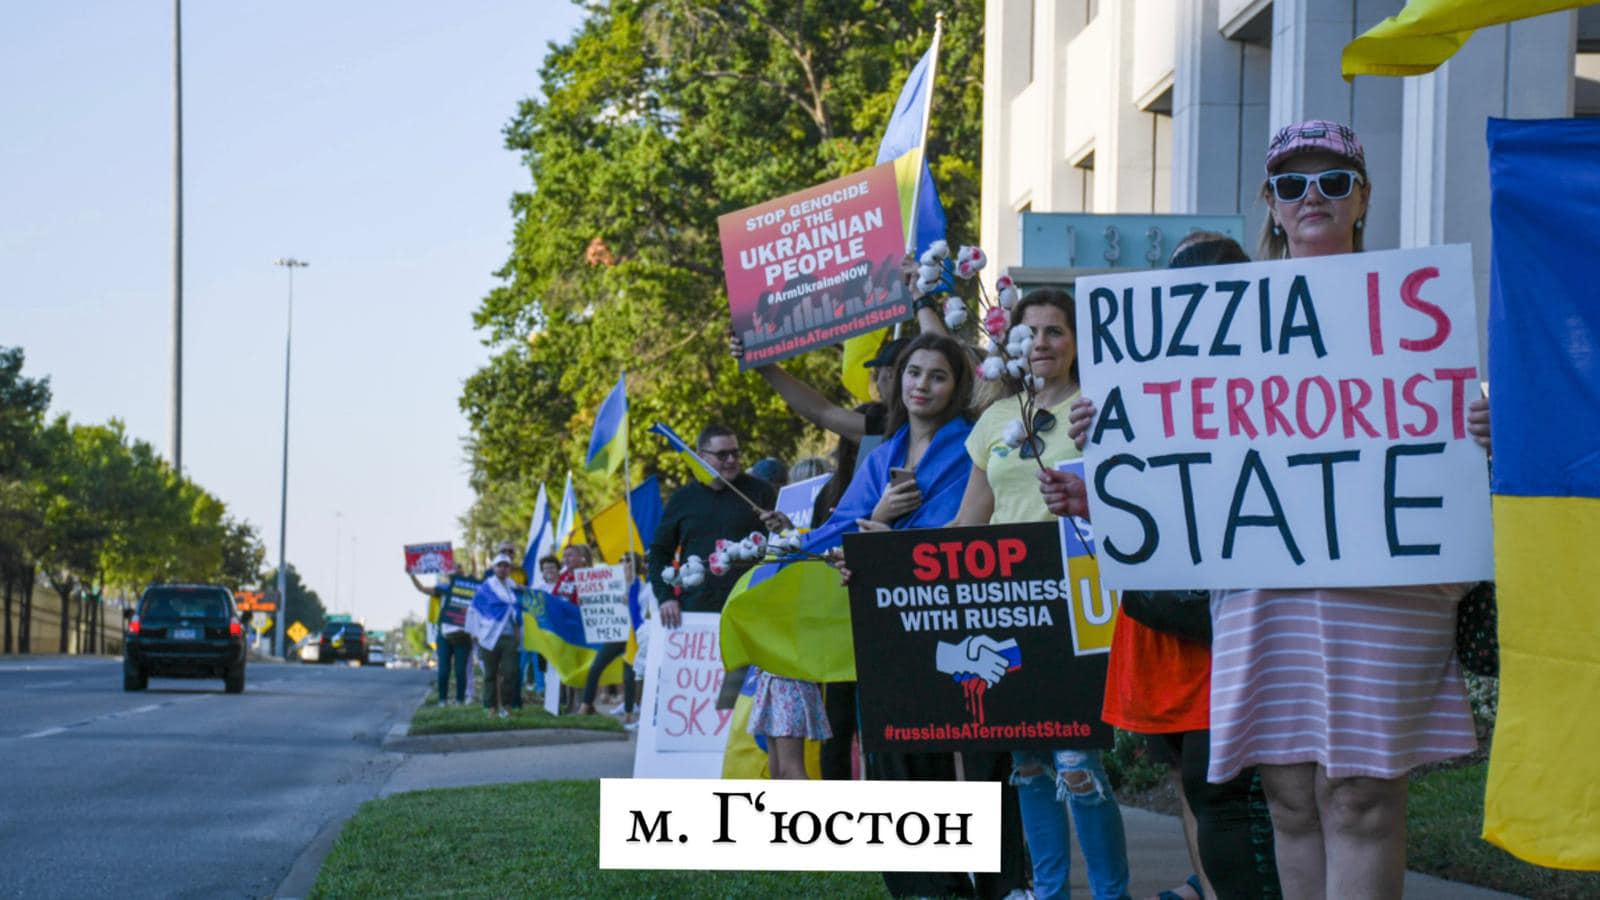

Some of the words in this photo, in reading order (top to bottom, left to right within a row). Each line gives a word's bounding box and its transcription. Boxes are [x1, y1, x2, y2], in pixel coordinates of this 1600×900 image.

[746, 209, 786, 232] STOP
[790, 180, 870, 218] GENOCIDE
[780, 219, 801, 236] OF
[804, 208, 834, 229] THE
[740, 207, 883, 270] UKRAINIAN
[764, 237, 866, 287] PEOPLE
[767, 263, 869, 305] #ArmUkraineNOW
[1089, 274, 1328, 365] RUZZIA
[1366, 266, 1452, 356] IS
[1091, 385, 1135, 445] A
[1143, 367, 1478, 440] TERRORIST
[1093, 442, 1446, 566] STATE
[912, 538, 1028, 581] STOP
[583, 607, 615, 616] THAN
[875, 585, 950, 608] DOING
[596, 627, 622, 640] MEN
[900, 609, 959, 632] WITH
[964, 605, 1054, 629] RUSSIA
[666, 631, 721, 661] SHEL
[665, 694, 733, 737] SKY
